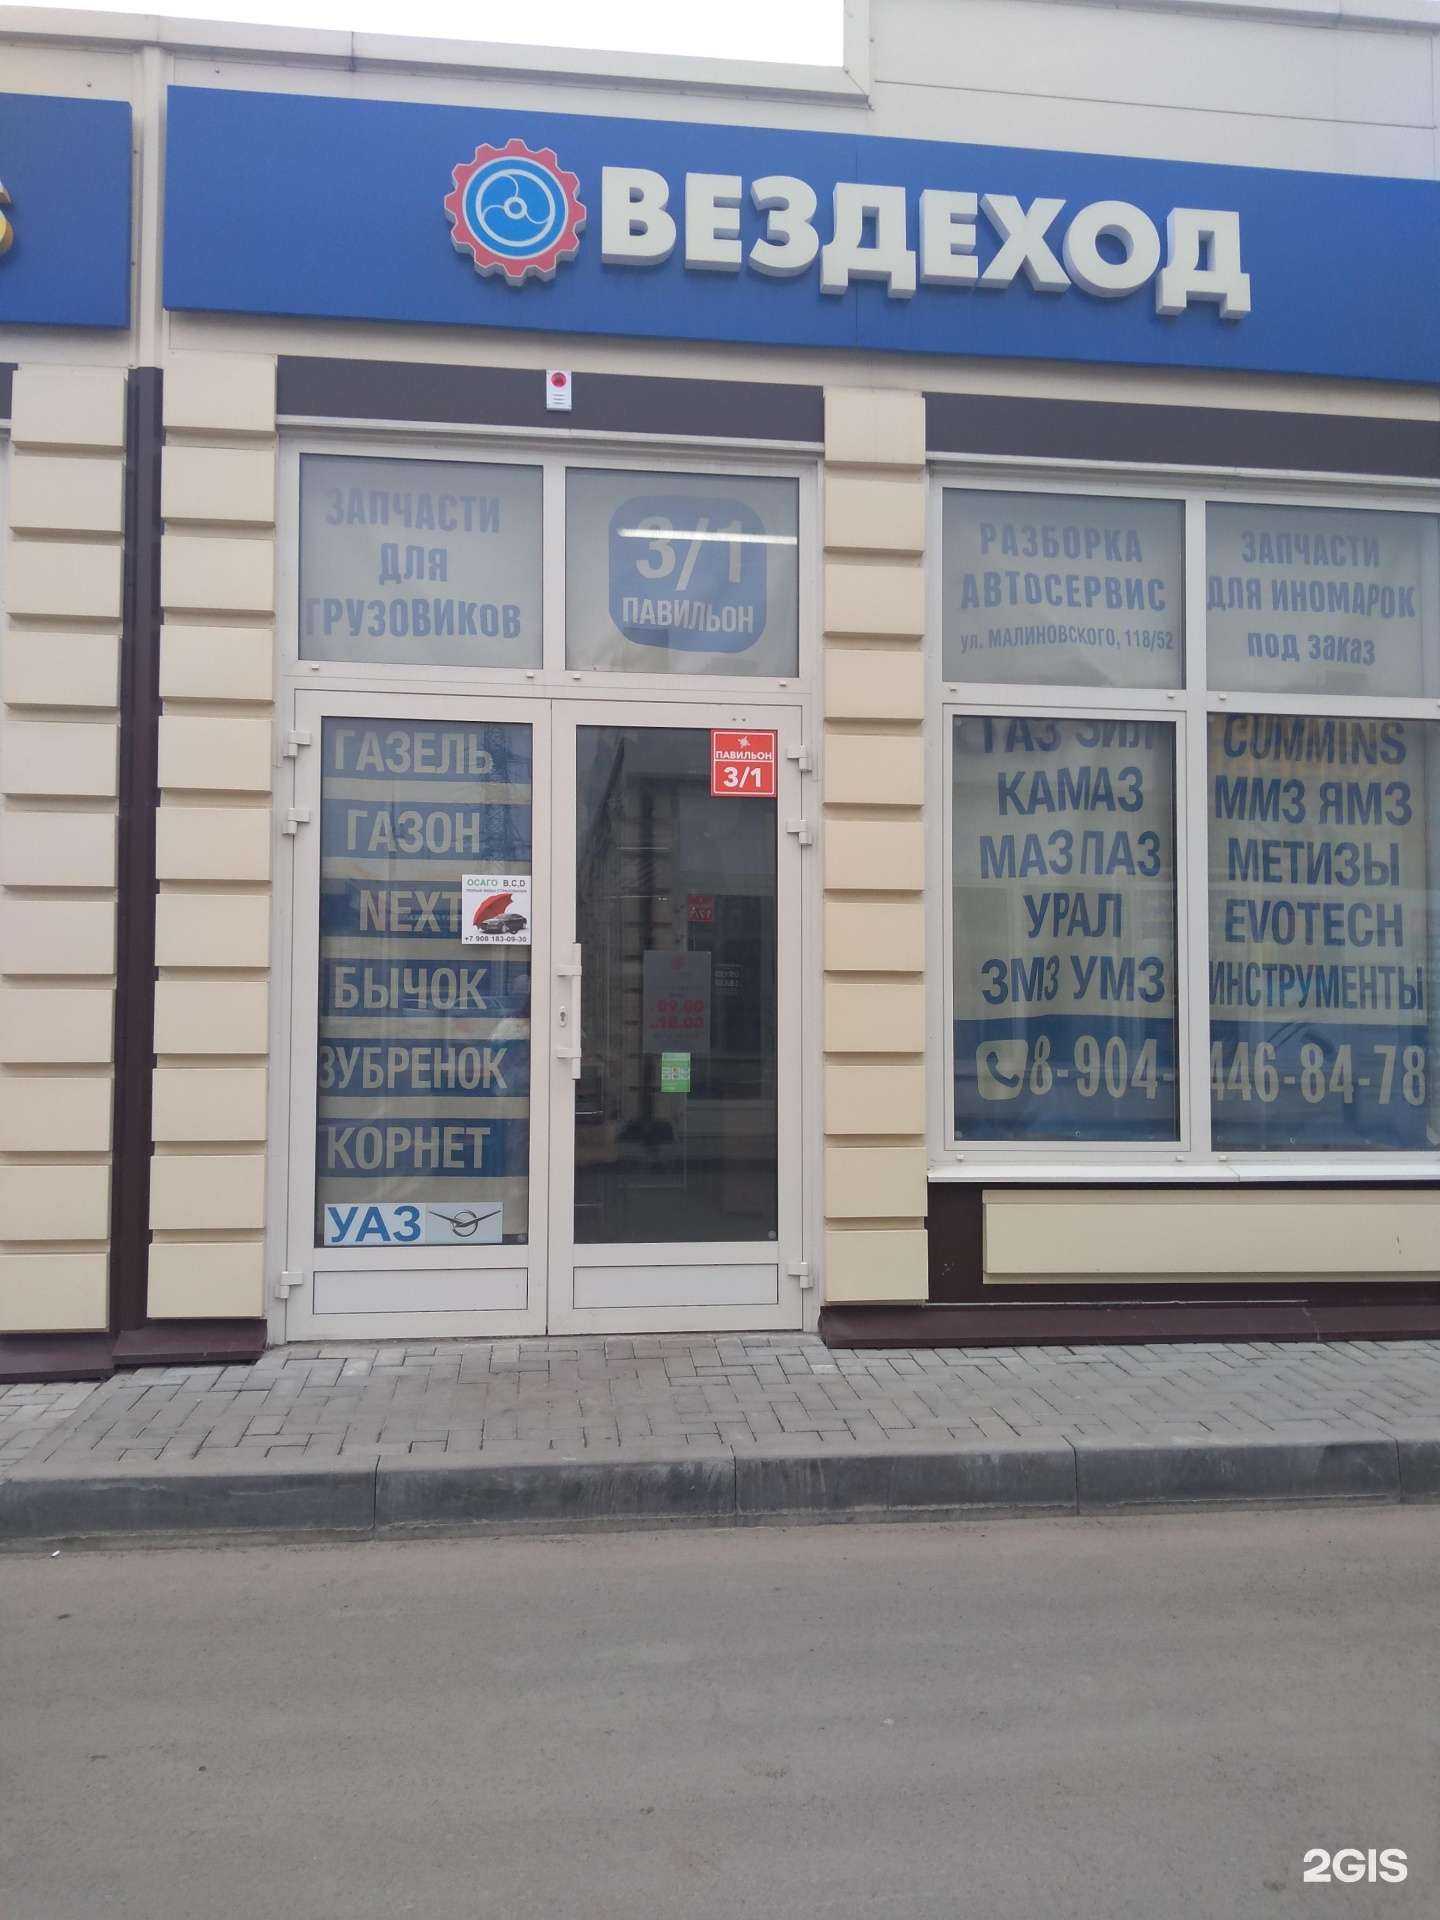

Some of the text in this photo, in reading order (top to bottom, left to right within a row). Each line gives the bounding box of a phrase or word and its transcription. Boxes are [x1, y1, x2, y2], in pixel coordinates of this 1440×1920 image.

[601, 166, 1251, 318] ВЕЗДЕХОД
[326, 488, 501, 533] ЗАПЧАСТИ
[378, 542, 449, 586] ДЛЯ
[636, 516, 743, 591] 3/1
[979, 522, 1143, 563] РАЗБОРКА
[1241, 530, 1380, 568] ЗАПЧАСТИ
[960, 571, 1167, 611] АВТОСЕРВИС
[1207, 576, 1416, 619] ДЛЯ ИНОМАРОК
[305, 598, 522, 639] ГРУЗОВИКОВ
[622, 597, 754, 633] ПАВИЛЬОН
[960, 633, 983, 654] ул.
[1125, 630, 1173, 651] 118/52
[333, 729, 494, 774] ГАЗЕЛЬ
[715, 750, 772, 760] ПАВИЛЬОН
[1223, 713, 1408, 765] CUMMINS
[723, 766, 761, 788] 3/1
[997, 766, 1144, 816] КАМАЗ
[1215, 774, 1413, 826] ММЗ ЯМЗ
[347, 809, 481, 853] ГАЗОН
[979, 829, 1161, 879] МАЗ ПАЗ
[1228, 838, 1400, 887] МЕТИЗЫ
[467, 878, 497, 887] ОСАГО
[359, 890, 462, 932] NEXT
[1022, 893, 1122, 938] УРАЛ
[1225, 898, 1404, 947] EVOTECH
[334, 966, 489, 1010] БЫЧОК
[981, 955, 1166, 1005] ЗМЗ УМЗ
[1209, 961, 1425, 1011] ИНСТРУМЕНТЫ
[319, 1046, 509, 1090] ЗУБРЕНОК
[1211, 1040, 1427, 1106] 446-84-78
[326, 1126, 491, 1170] КОРНЕТ
[326, 1205, 422, 1243] УАЗ
